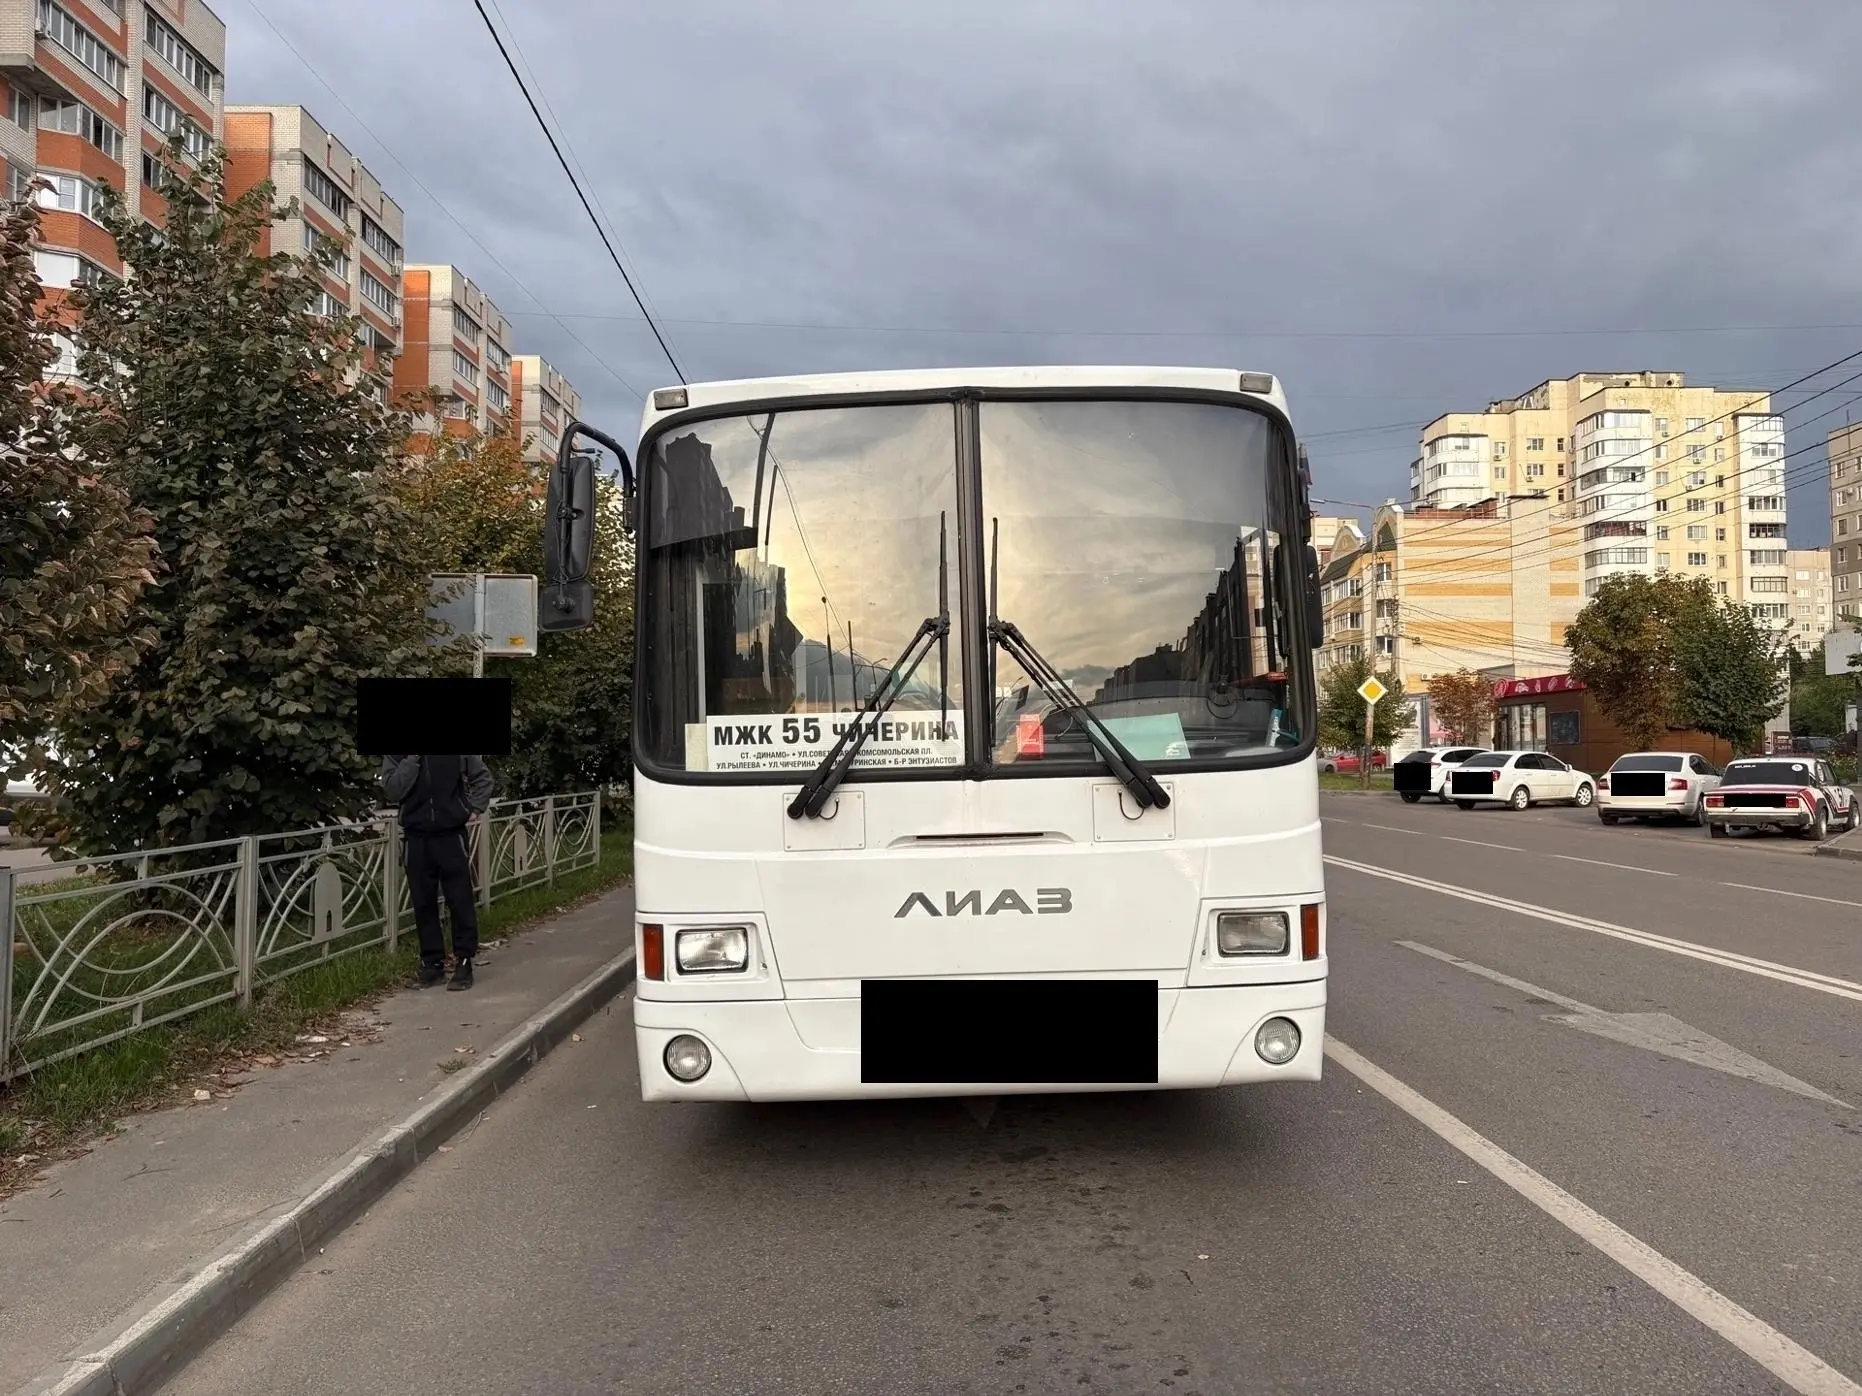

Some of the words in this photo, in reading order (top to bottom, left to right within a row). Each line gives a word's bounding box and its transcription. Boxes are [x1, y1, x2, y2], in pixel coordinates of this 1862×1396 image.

[714, 724, 773, 746] МЖК
[782, 717, 821, 744] 55
[832, 721, 959, 742] ЧИЧЕРИНА
[740, 752, 752, 760] СТ.
[893, 887, 1073, 918] ЛИАЗ
